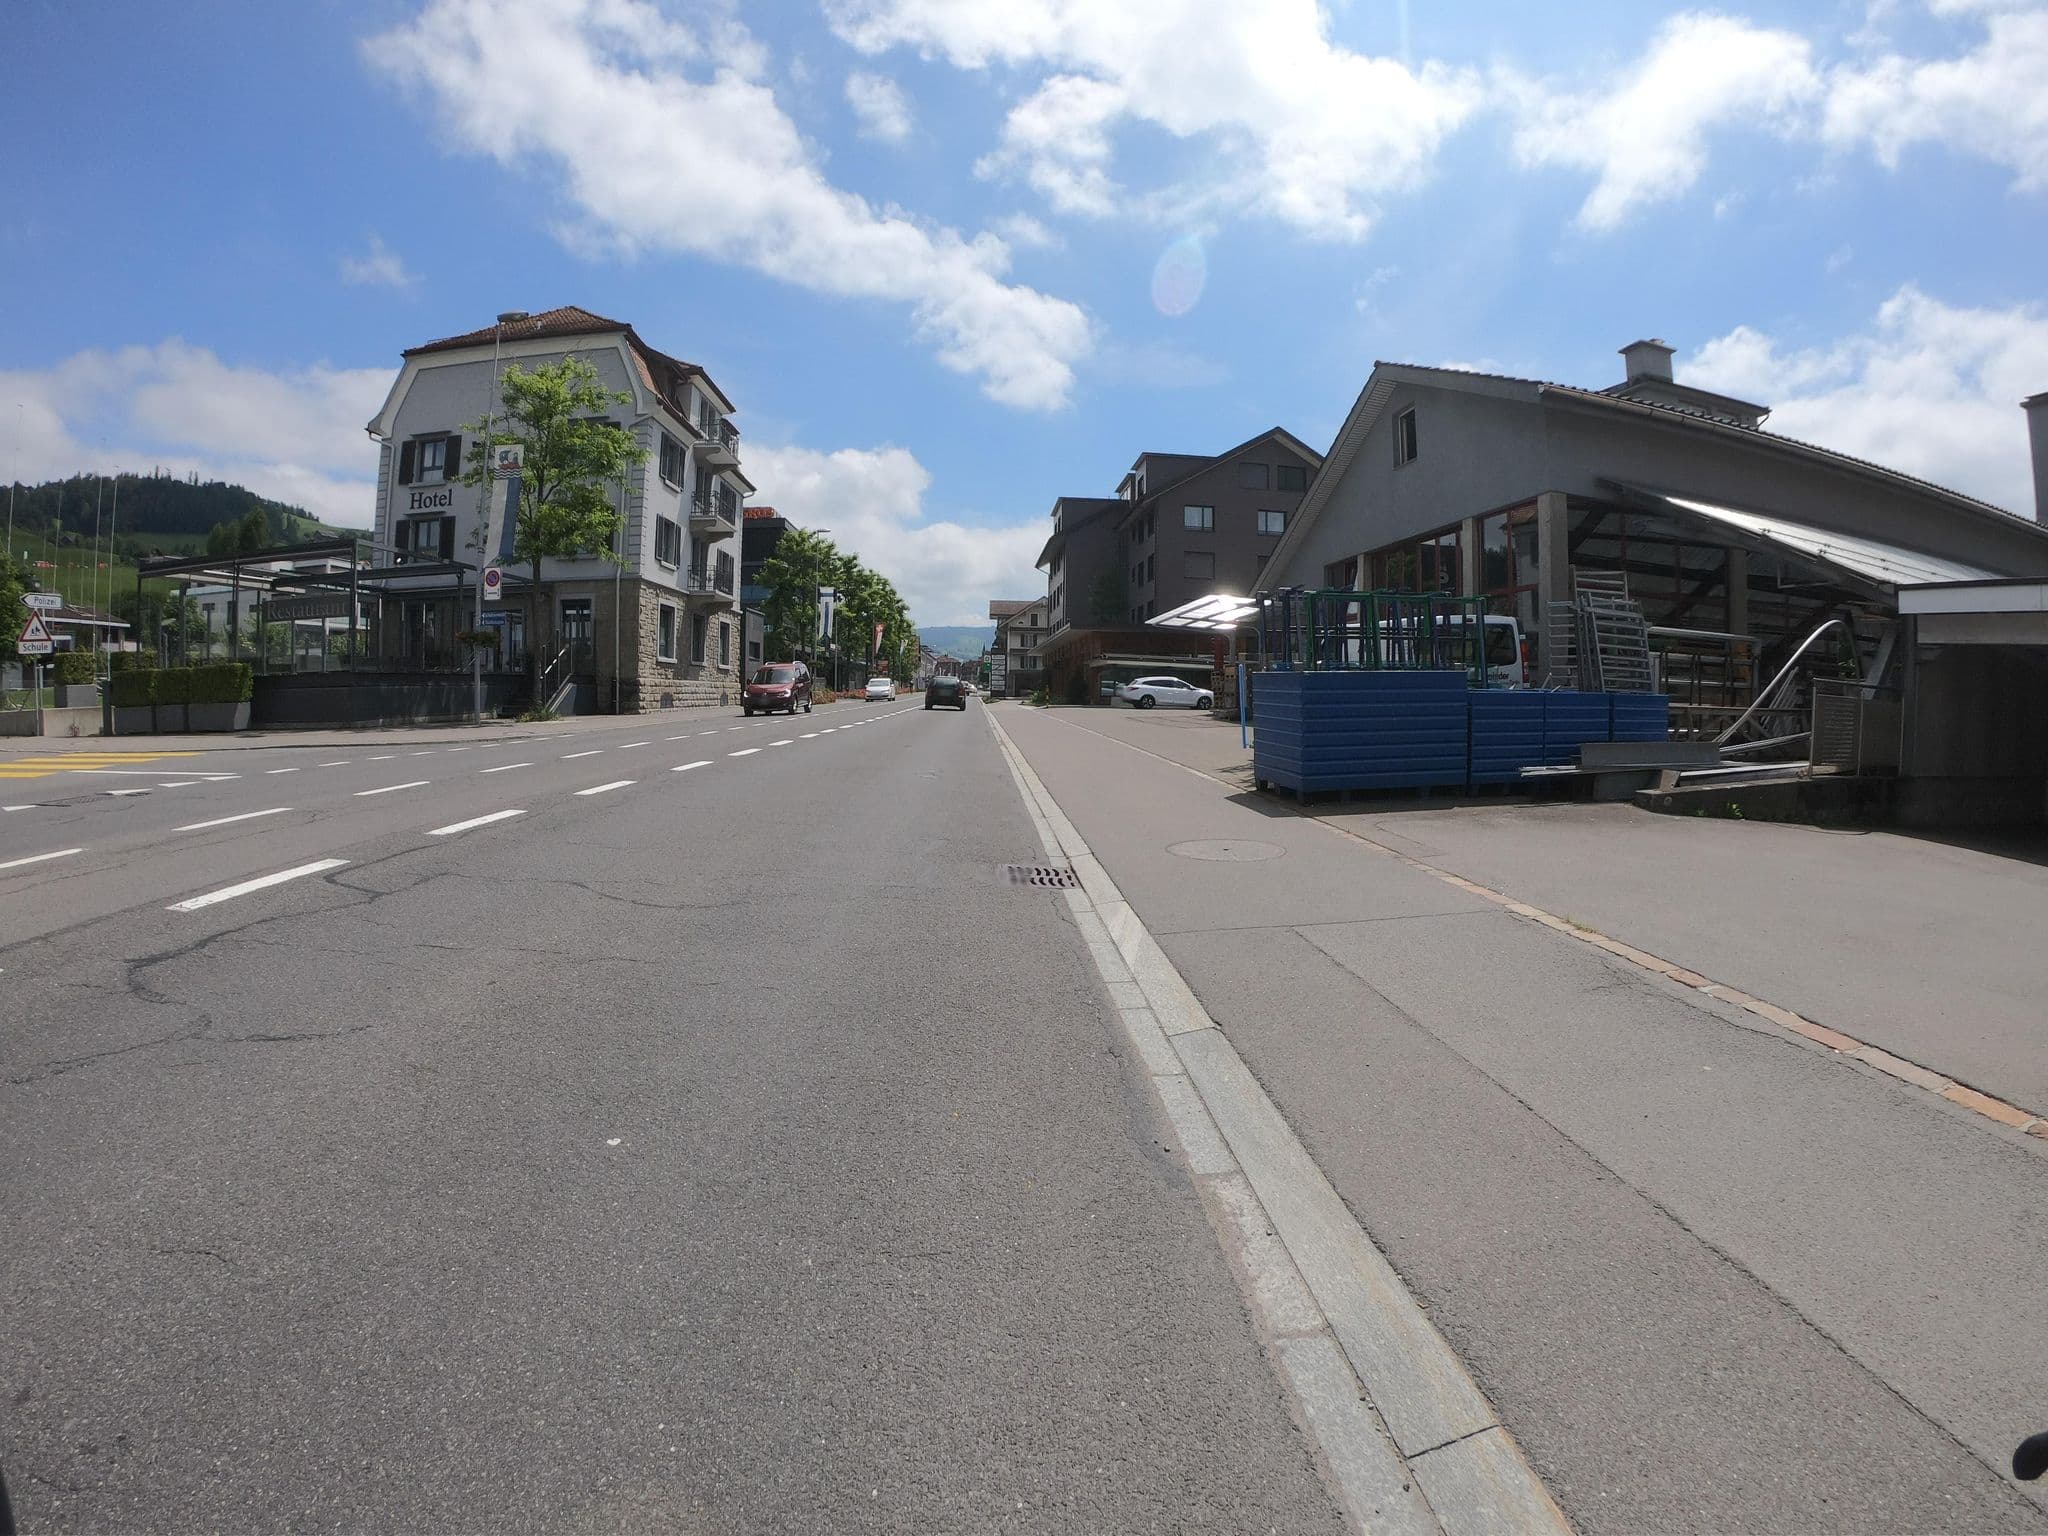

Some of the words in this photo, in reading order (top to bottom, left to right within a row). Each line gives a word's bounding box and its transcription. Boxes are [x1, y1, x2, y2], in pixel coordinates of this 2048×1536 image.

[409, 489, 453, 509] Hotel
[34, 596, 57, 606] Polizei
[266, 601, 348, 619] Restaurant
[22, 642, 49, 652] Schule
